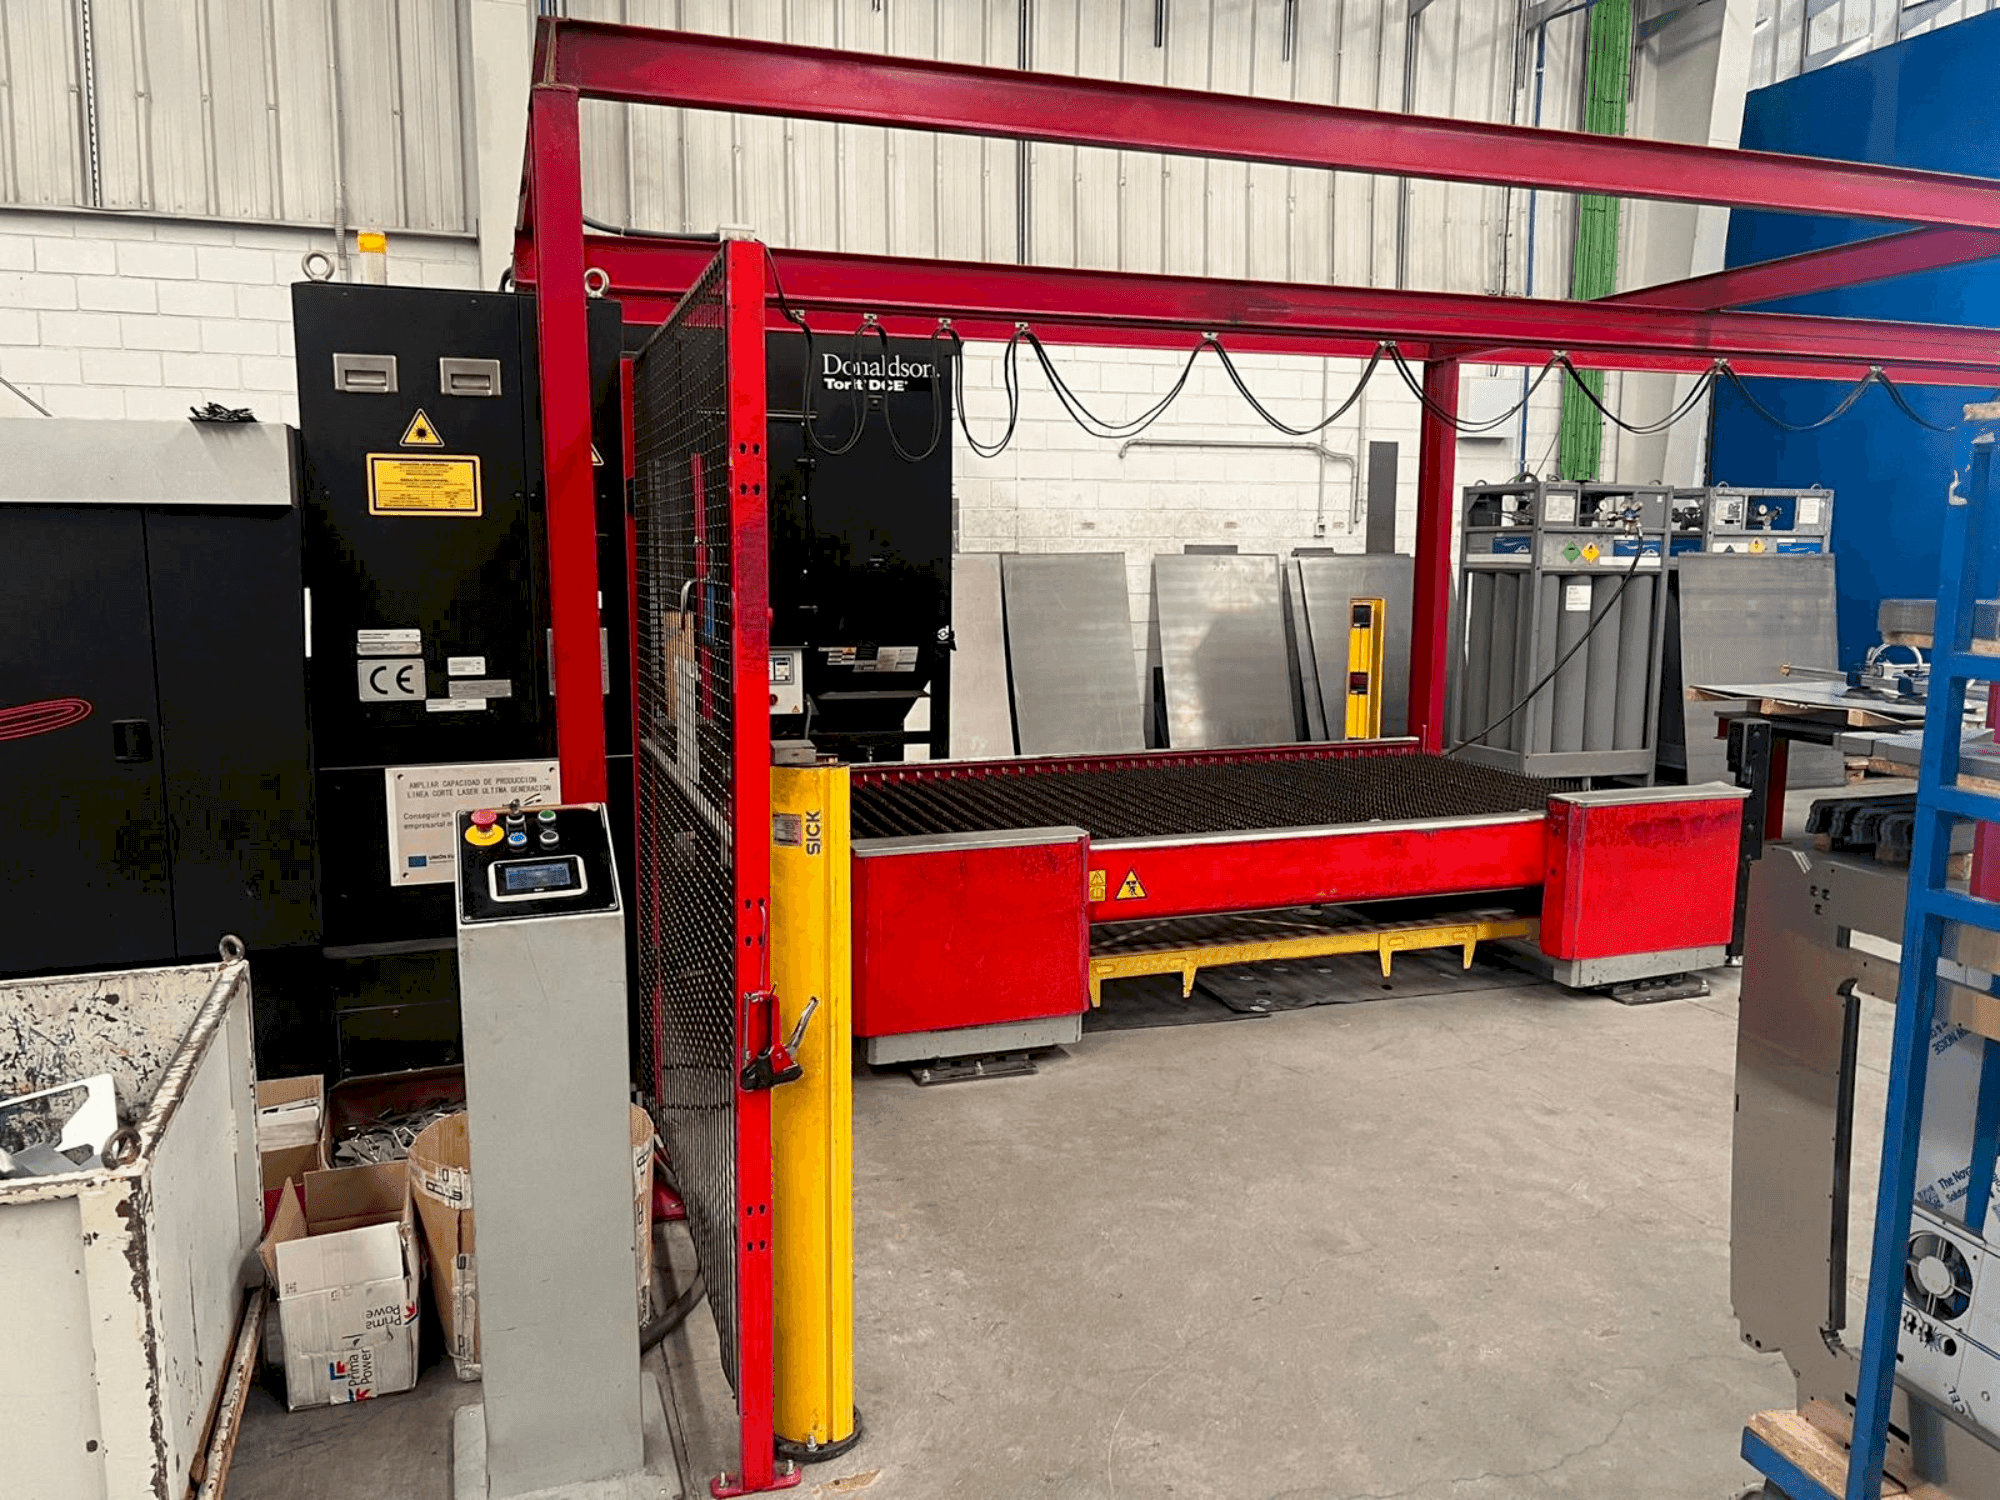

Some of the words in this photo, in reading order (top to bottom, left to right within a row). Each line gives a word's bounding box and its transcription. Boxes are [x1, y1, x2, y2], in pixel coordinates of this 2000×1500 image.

[369, 664, 415, 695] CE
[409, 780, 440, 789] AMPLIAR
[442, 778, 481, 788] CAPACIDAD
[483, 778, 493, 786] DE
[495, 776, 538, 786] PRODUCCION
[407, 790, 429, 799] LINEA
[432, 788, 454, 798] CORTE
[457, 787, 480, 796] LASER
[482, 785, 507, 794] ULTIMA
[510, 784, 552, 793] GENERACION
[403, 811, 440, 822] Conseguir
[403, 820, 447, 830] empresarial
[805, 809, 821, 855] SICK
[365, 1314, 402, 1330] Prima
[348, 1354, 361, 1387] Prima
[360, 1348, 373, 1385] Power
